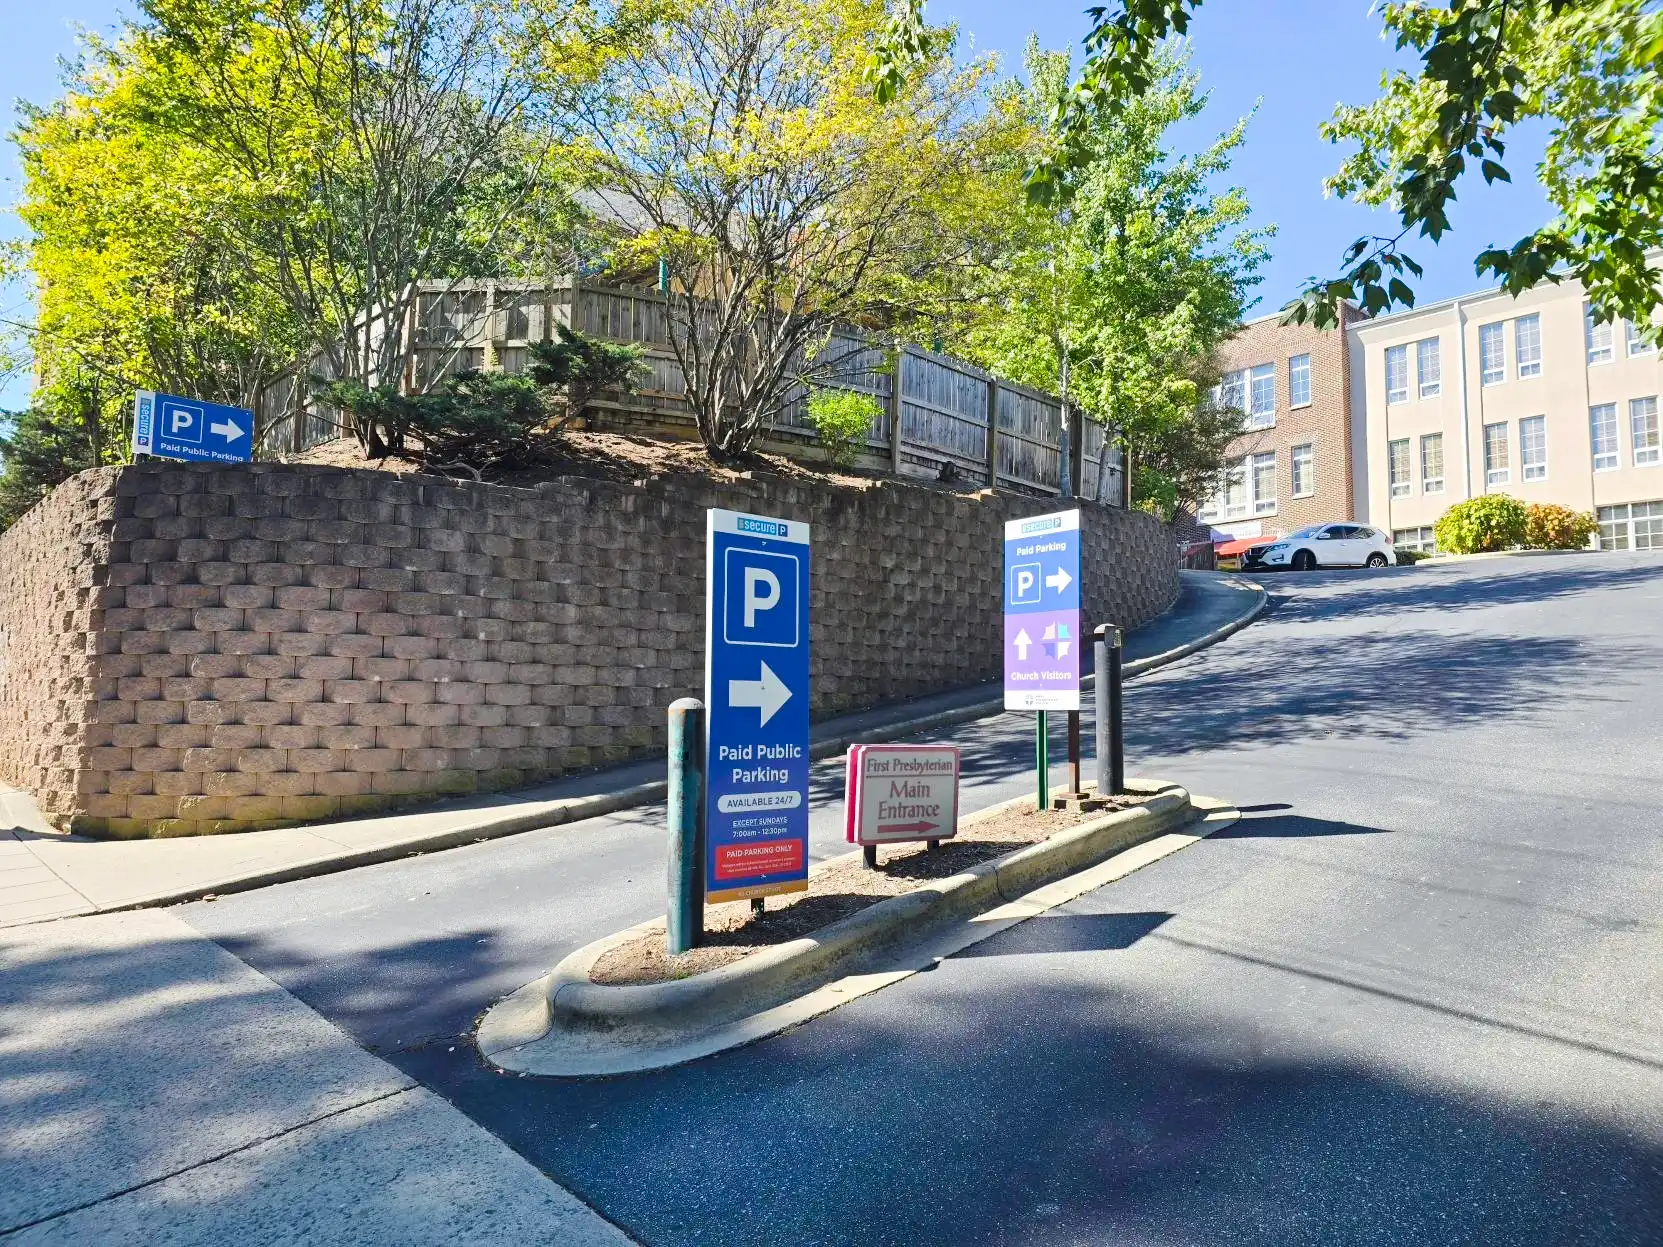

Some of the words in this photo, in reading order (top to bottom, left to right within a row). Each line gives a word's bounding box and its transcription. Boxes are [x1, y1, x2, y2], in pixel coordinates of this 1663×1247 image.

[139, 404, 150, 435] secure
[171, 409, 193, 433] P
[160, 442, 181, 452] Paid
[182, 446, 210, 457] Public
[211, 450, 244, 462] Parking
[744, 520, 776, 534] secure
[780, 525, 786, 535] P
[1016, 545, 1034, 556] Paid
[1035, 541, 1067, 554] Parking
[1017, 571, 1034, 598] P
[744, 566, 781, 628] P
[1010, 670, 1039, 681] Church
[1041, 670, 1072, 680] Visitors
[719, 744, 753, 760] Paid
[757, 743, 801, 759] Public
[866, 758, 889, 772] First
[892, 757, 953, 774] Presbyterian
[732, 766, 789, 784] Parking
[889, 780, 930, 798] Main
[727, 797, 773, 808] AVAILABLE
[775, 795, 794, 805] 24/7
[878, 800, 940, 820] Entrance
[732, 818, 758, 828] EXCEPT
[759, 816, 788, 826] SUNDAYS
[726, 849, 743, 858] PAID
[744, 846, 774, 857] PARKING
[775, 844, 793, 853] ONLY
